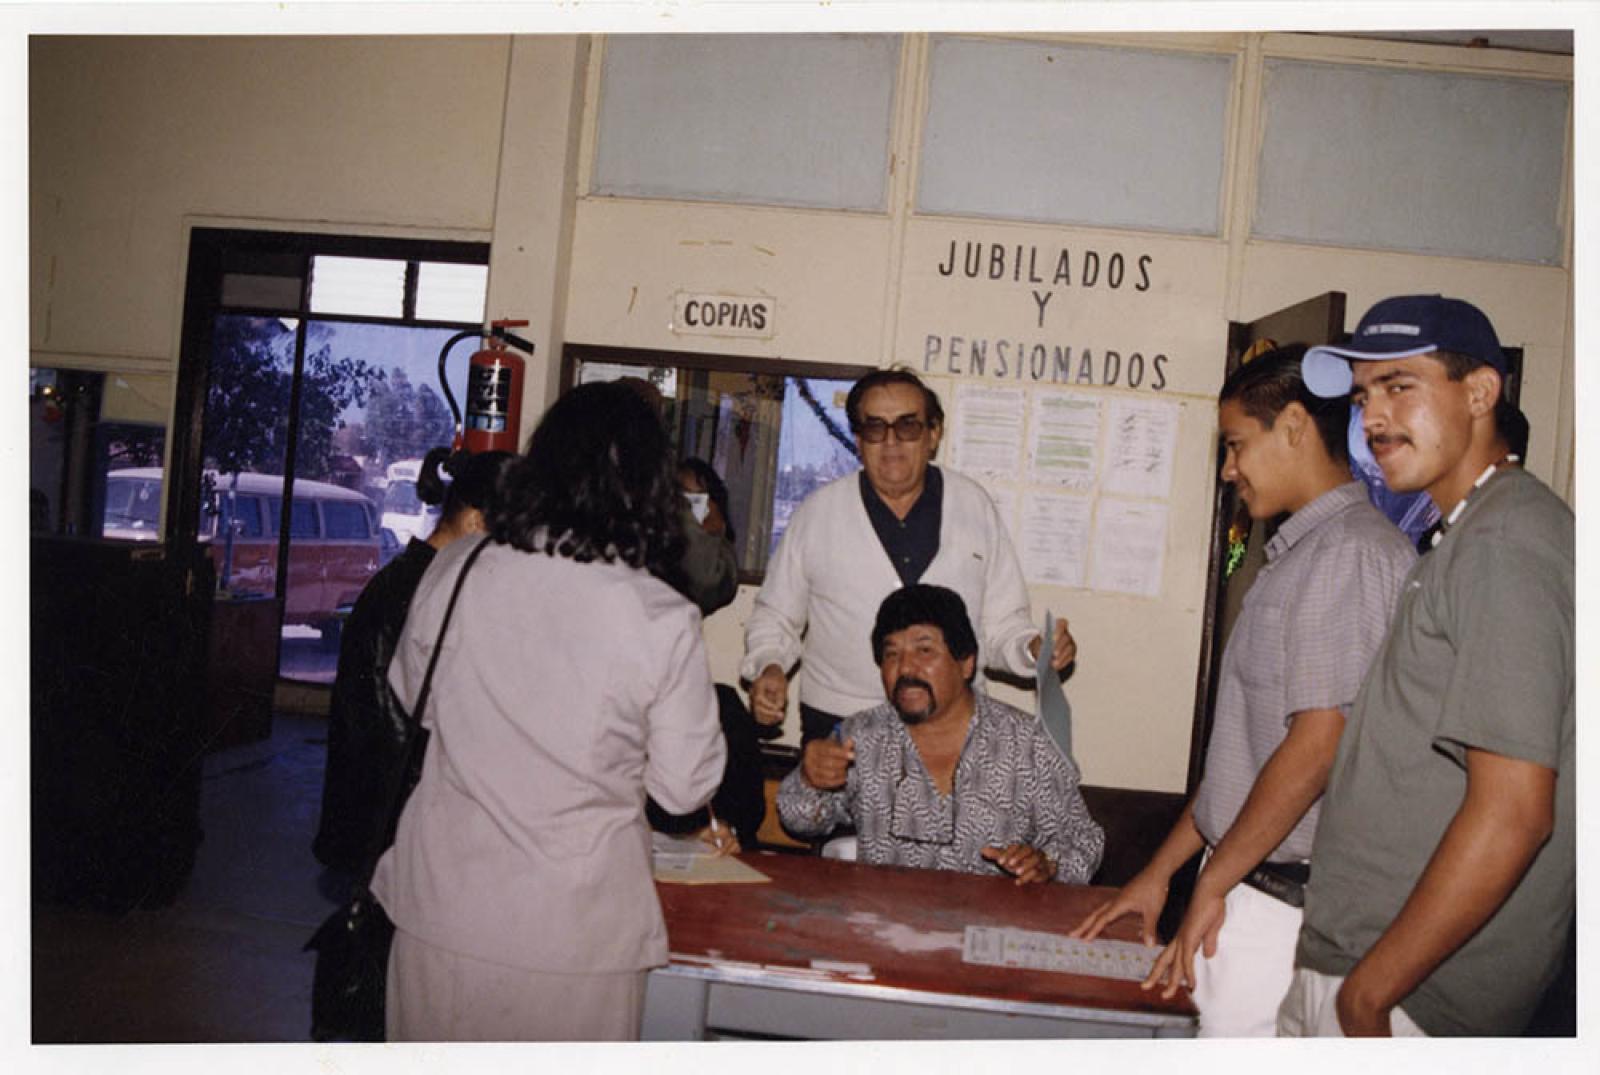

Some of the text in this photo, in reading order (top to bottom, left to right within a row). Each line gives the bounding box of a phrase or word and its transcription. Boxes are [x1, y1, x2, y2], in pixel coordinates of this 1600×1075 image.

[938, 240, 1153, 291] JUBILADOS
[684, 300, 767, 330] COPIAS
[1032, 290, 1053, 328] Y
[923, 334, 1169, 391] PENSIONADOS
